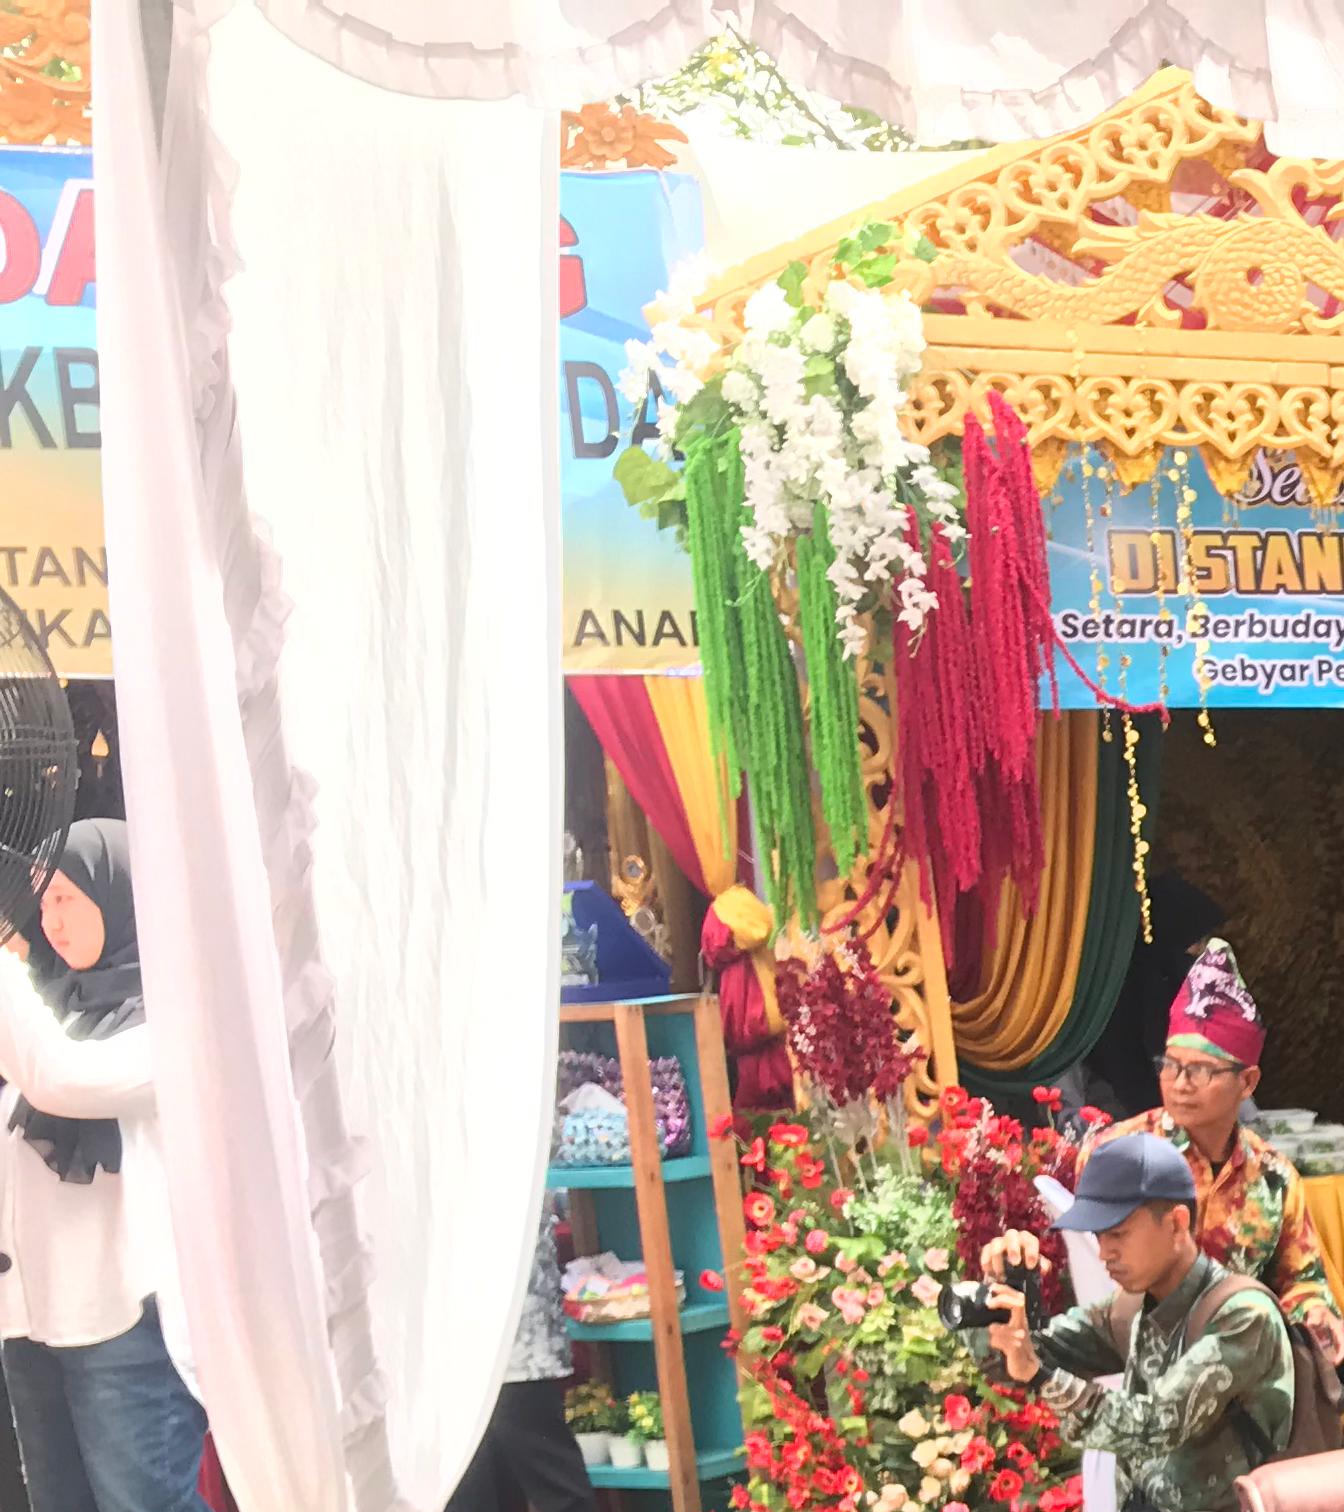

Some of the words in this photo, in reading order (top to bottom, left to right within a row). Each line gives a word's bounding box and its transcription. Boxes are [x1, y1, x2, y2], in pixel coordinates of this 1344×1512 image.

[1108, 530, 1178, 595] DI
[573, 609, 699, 646] ANA
[1061, 613, 1183, 644] Setara,
